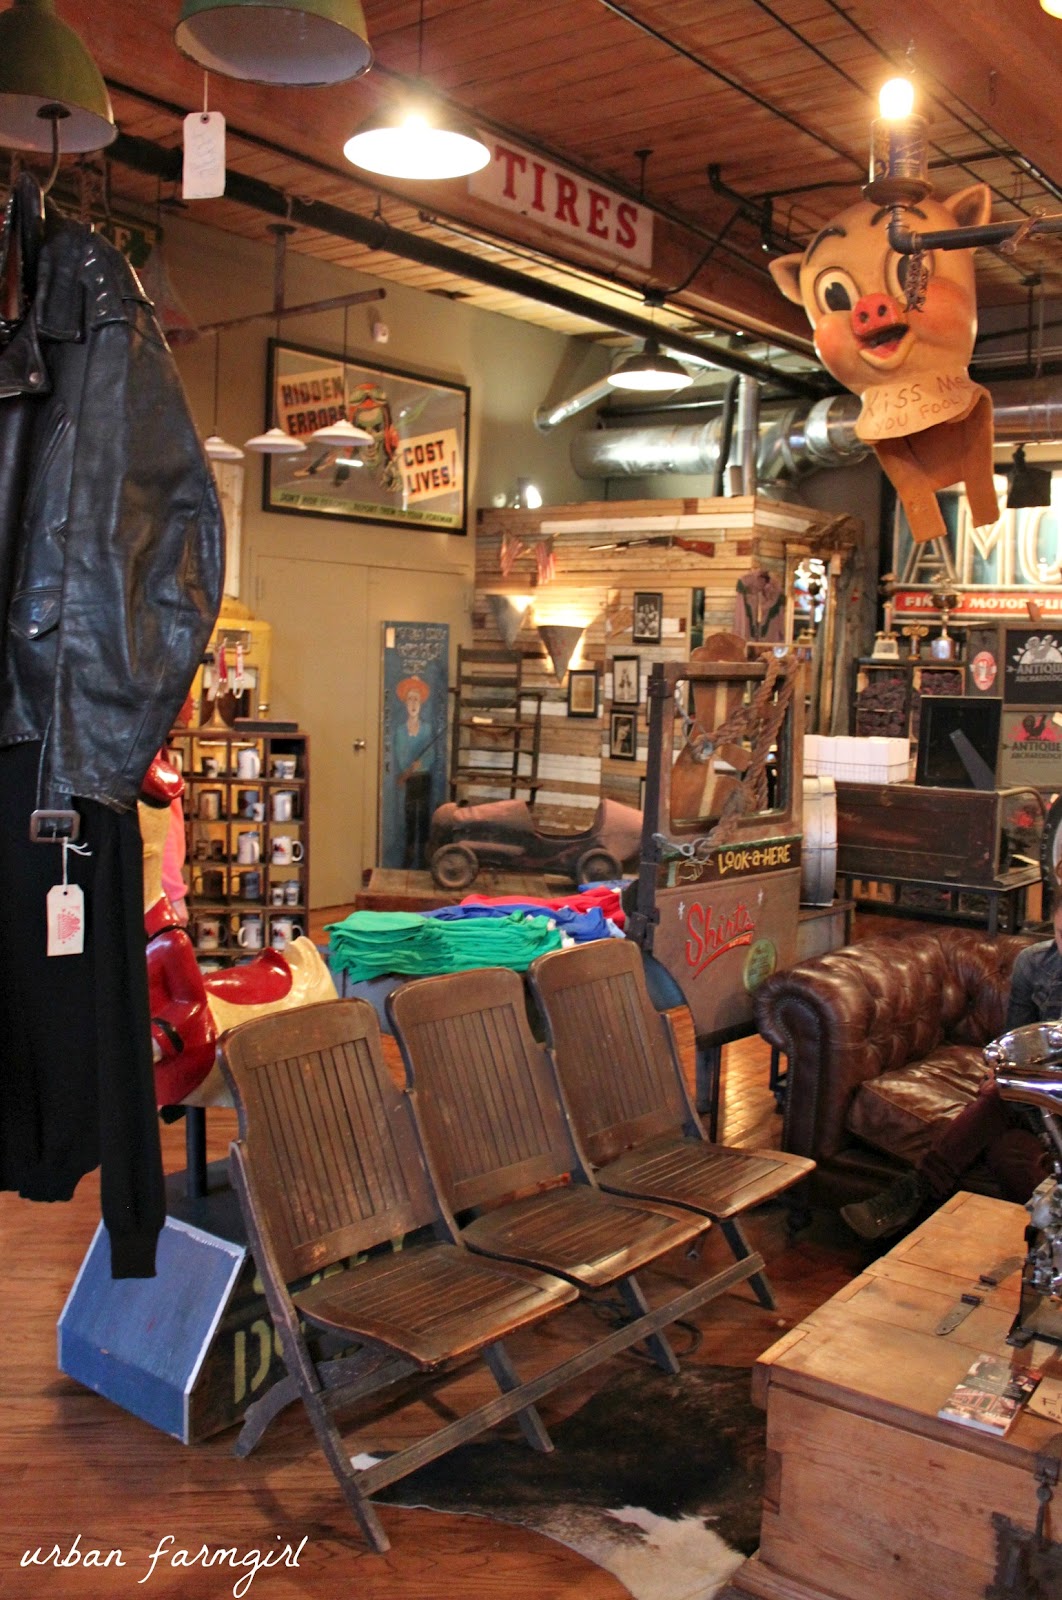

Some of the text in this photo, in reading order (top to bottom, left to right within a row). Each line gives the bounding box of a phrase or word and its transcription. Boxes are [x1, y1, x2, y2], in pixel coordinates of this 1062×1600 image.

[494, 144, 639, 250] TIRES
[281, 377, 345, 407] HIDDEN
[286, 405, 348, 437] ERRORS
[403, 440, 445, 468] COST
[406, 451, 457, 493] LIVES!
[969, 597, 1030, 610] MOTOR
[685, 902, 755, 966] Shirts
